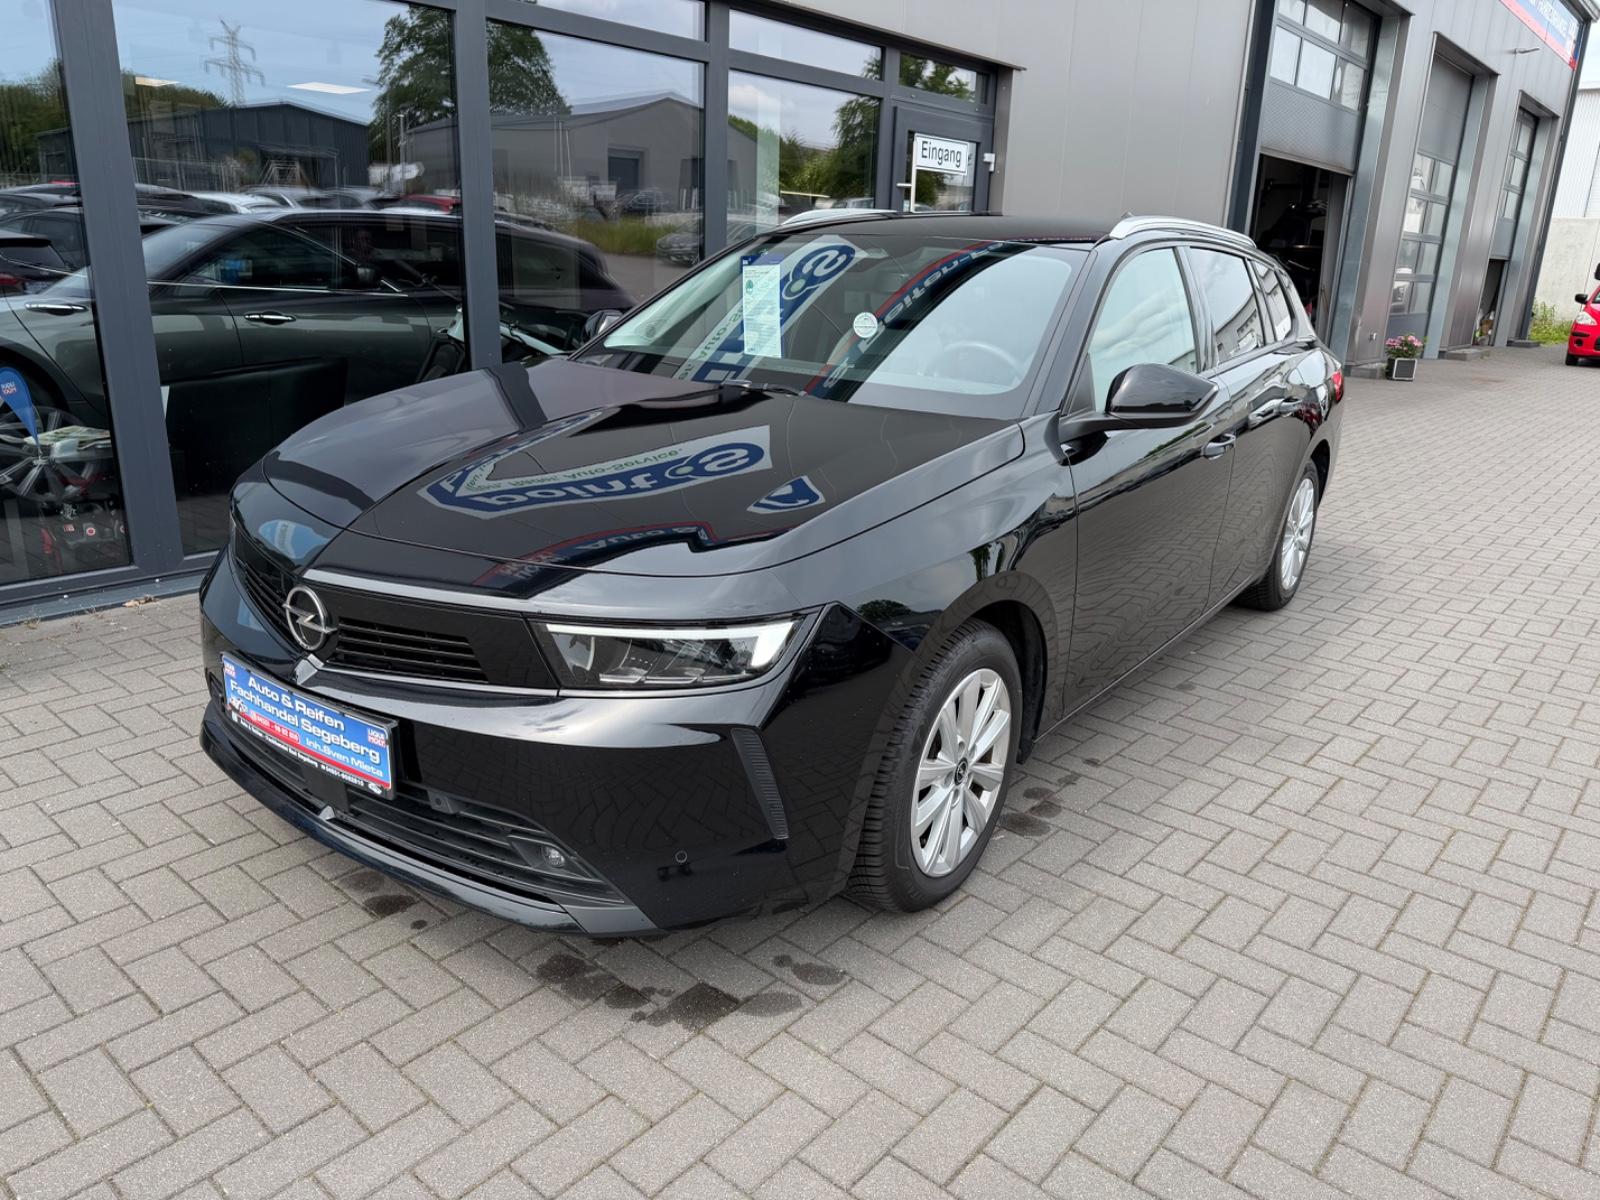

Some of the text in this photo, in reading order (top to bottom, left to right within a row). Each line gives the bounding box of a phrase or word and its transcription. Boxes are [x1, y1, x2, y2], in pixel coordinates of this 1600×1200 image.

[921, 140, 962, 168] Eingang
[230, 680, 298, 727] Fachhandel
[301, 718, 380, 764] Segeberg
[248, 677, 280, 702] Auto
[281, 694, 294, 709] &
[295, 700, 344, 731] Reifen
